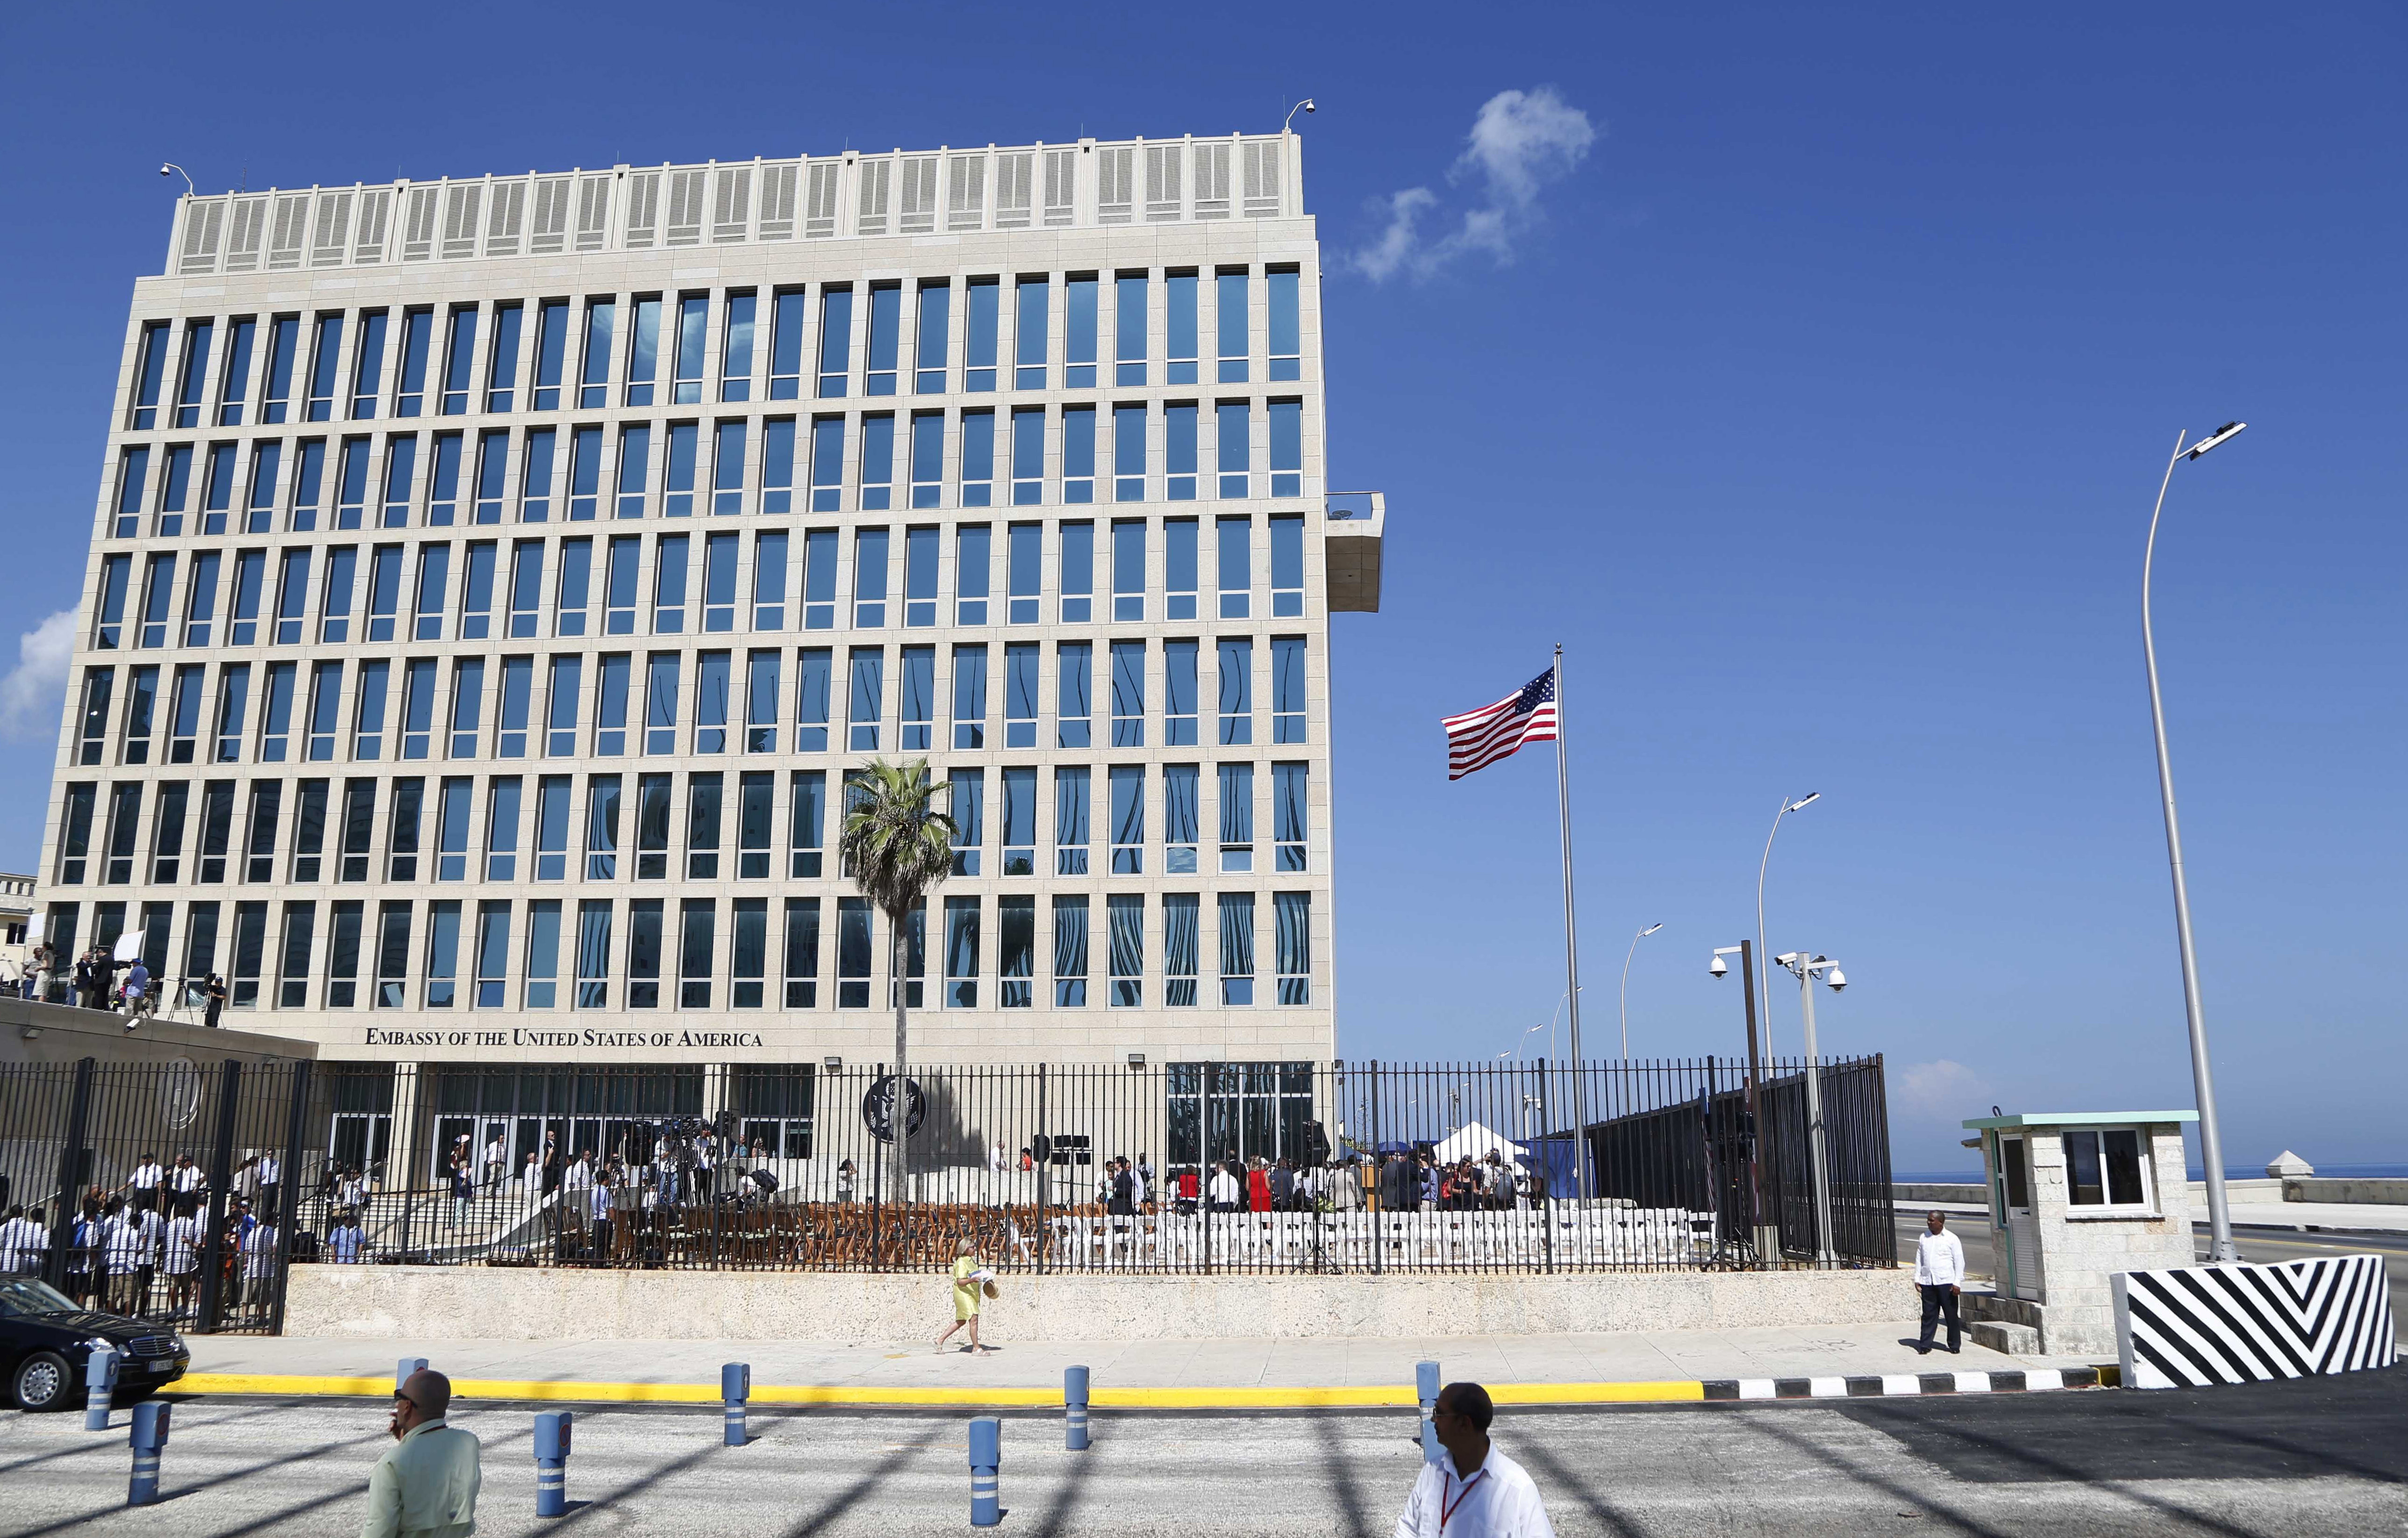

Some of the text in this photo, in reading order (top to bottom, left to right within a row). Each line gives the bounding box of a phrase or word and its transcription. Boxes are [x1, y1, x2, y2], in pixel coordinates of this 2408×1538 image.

[365, 1028, 763, 1046] EMBASSY OF THE UNITED STATES OF AMERICA
